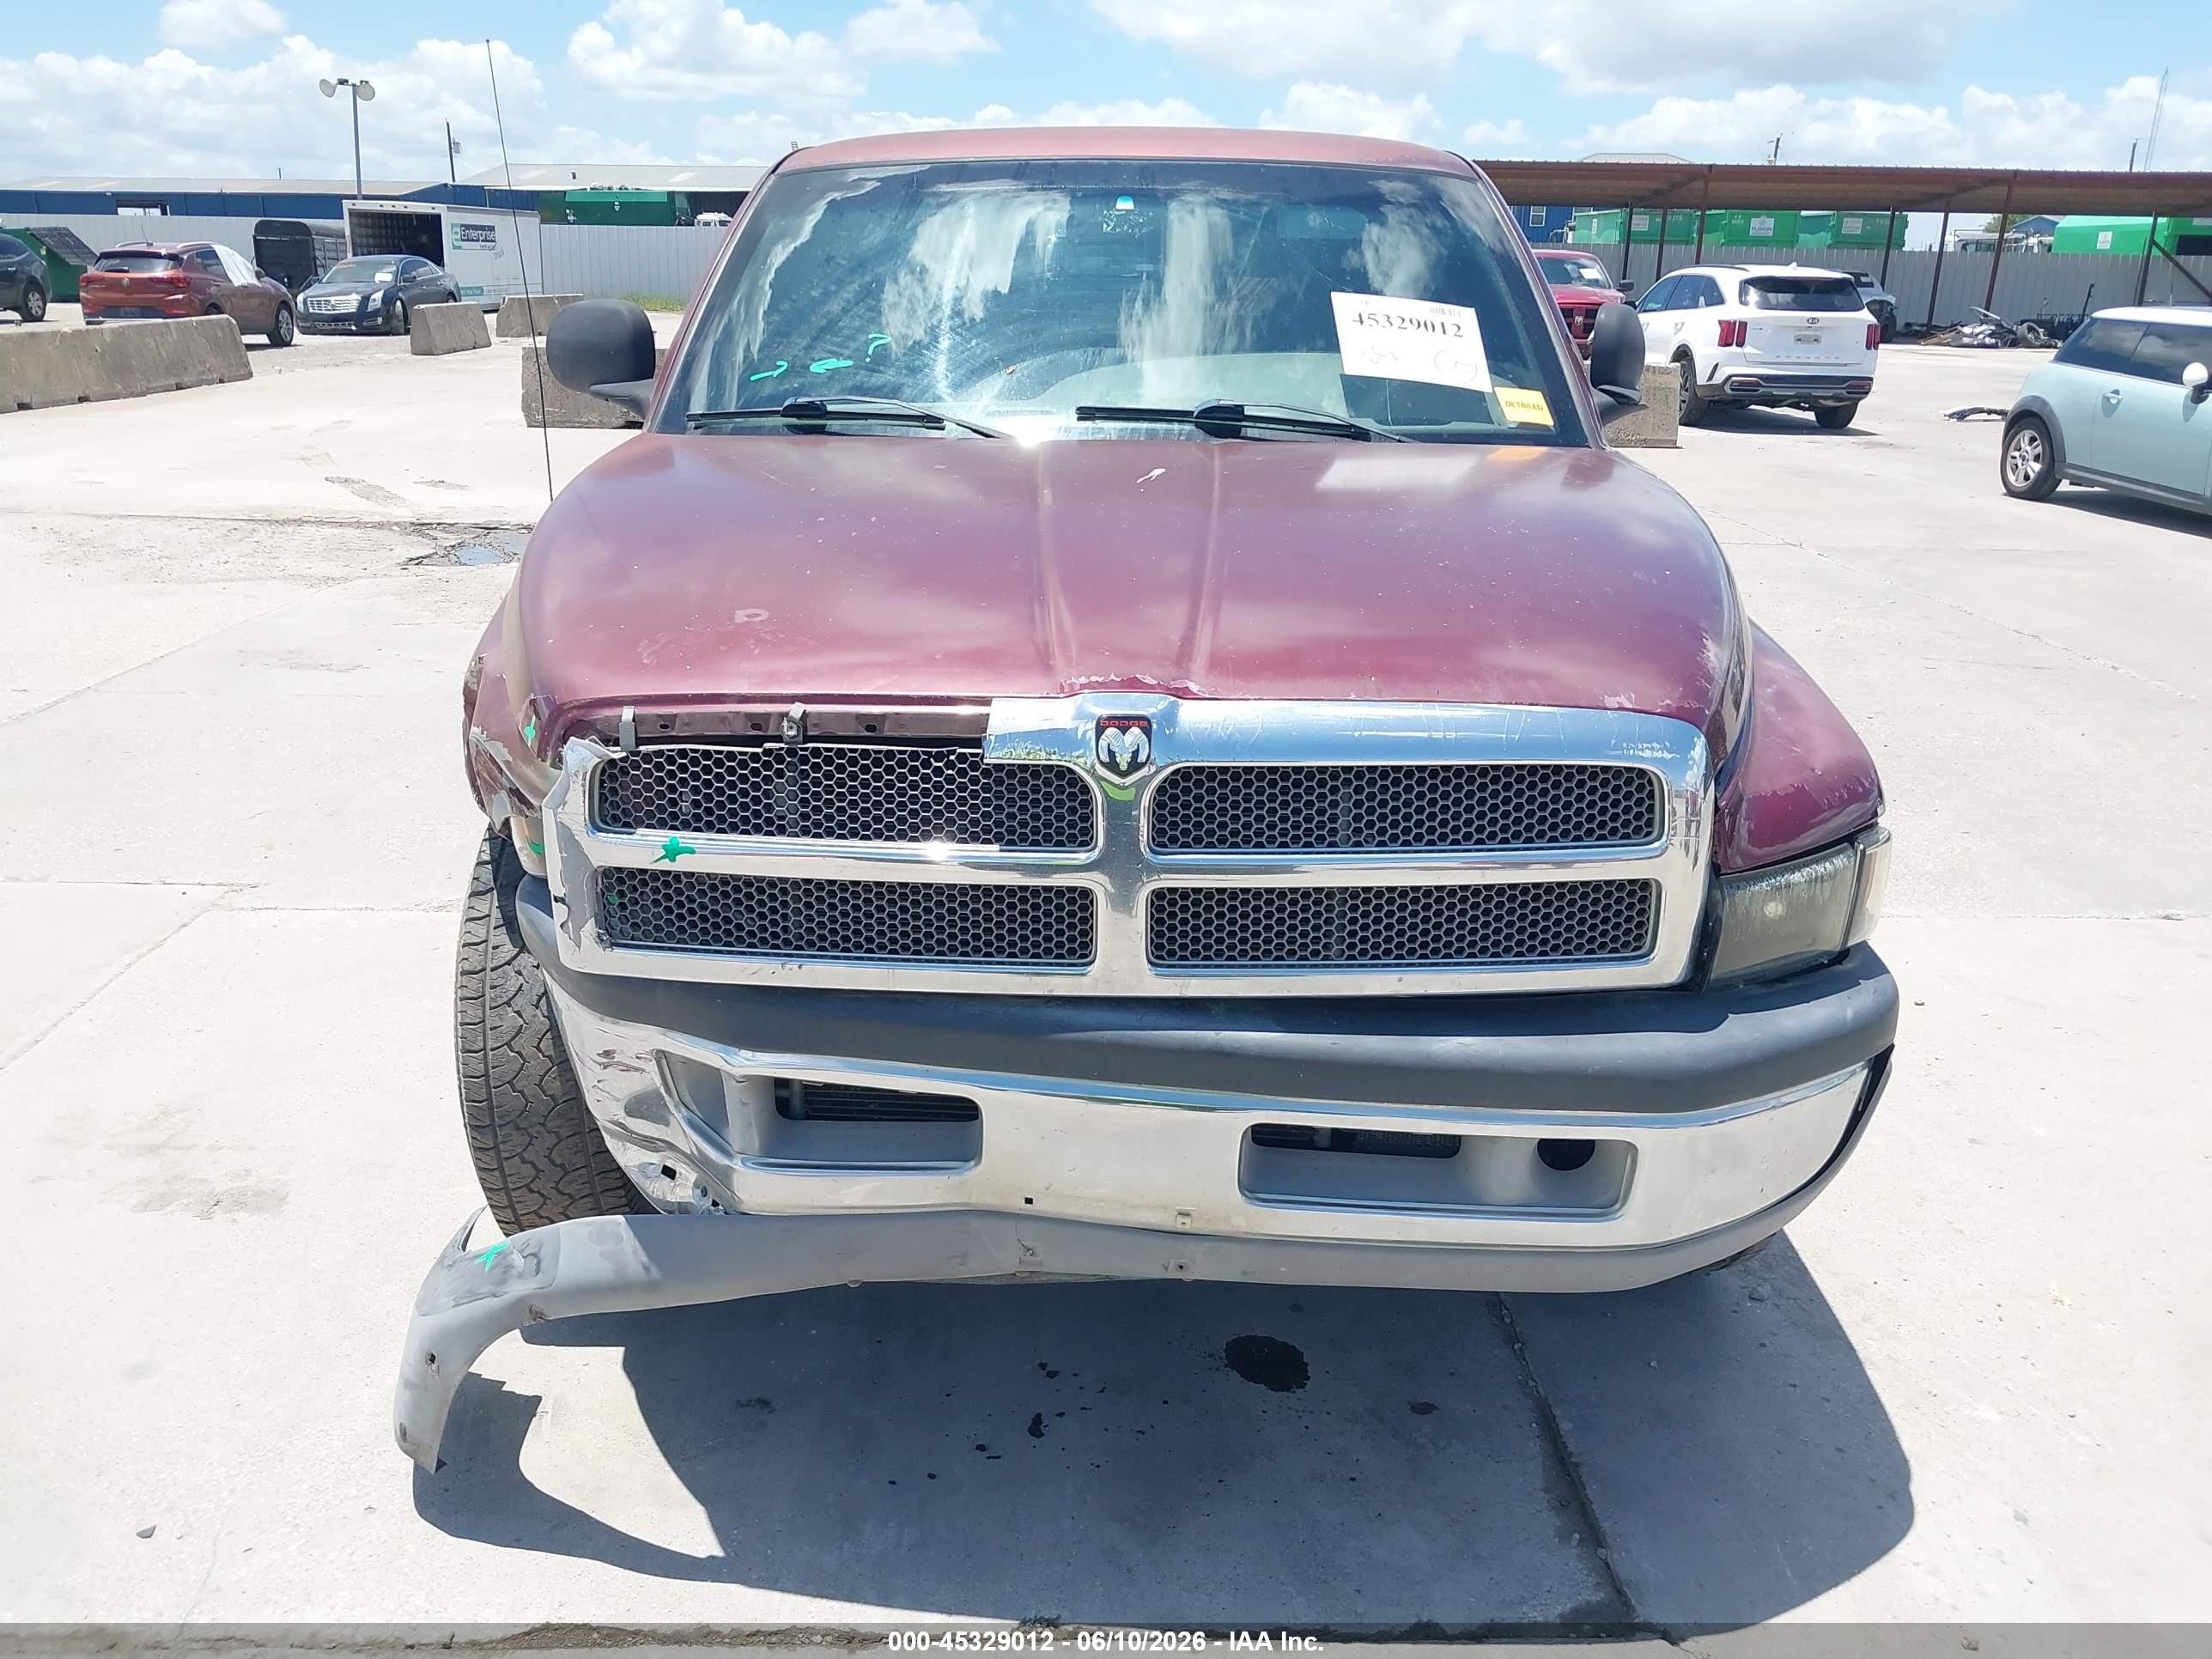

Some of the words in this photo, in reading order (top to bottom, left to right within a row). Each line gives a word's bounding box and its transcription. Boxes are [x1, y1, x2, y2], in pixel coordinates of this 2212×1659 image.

[461, 227, 495, 242] Enterprise
[1352, 312, 1464, 337] 45329012
[1505, 400, 1544, 411] DETAILED
